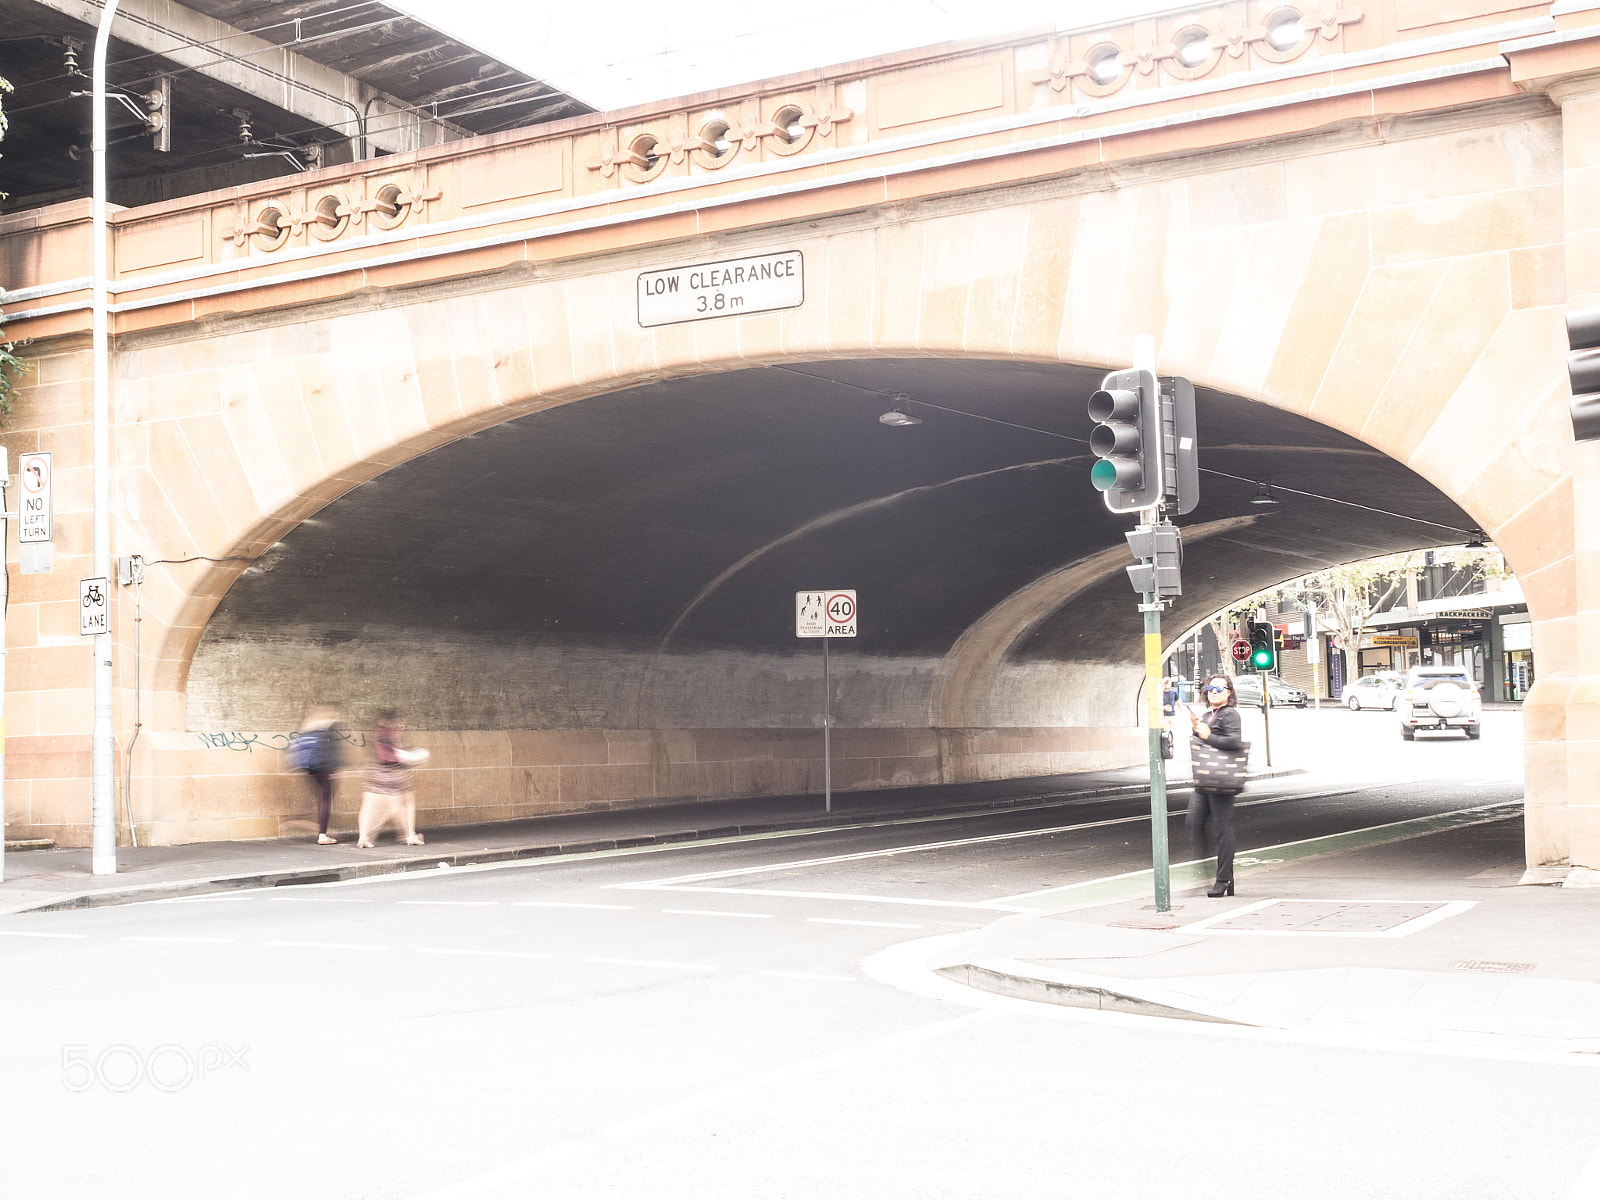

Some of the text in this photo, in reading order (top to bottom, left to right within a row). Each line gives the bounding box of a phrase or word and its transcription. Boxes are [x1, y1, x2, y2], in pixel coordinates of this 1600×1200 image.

[646, 259, 795, 296] LOW CLEARANCE
[696, 293, 744, 313] 3.8 m
[26, 497, 43, 511] NO
[24, 514, 45, 525] LEFT
[23, 527, 46, 537] TURN
[829, 601, 852, 616] 40
[82, 613, 105, 629] LANE
[827, 625, 856, 635] AREA
[1233, 646, 1251, 655] STOP
